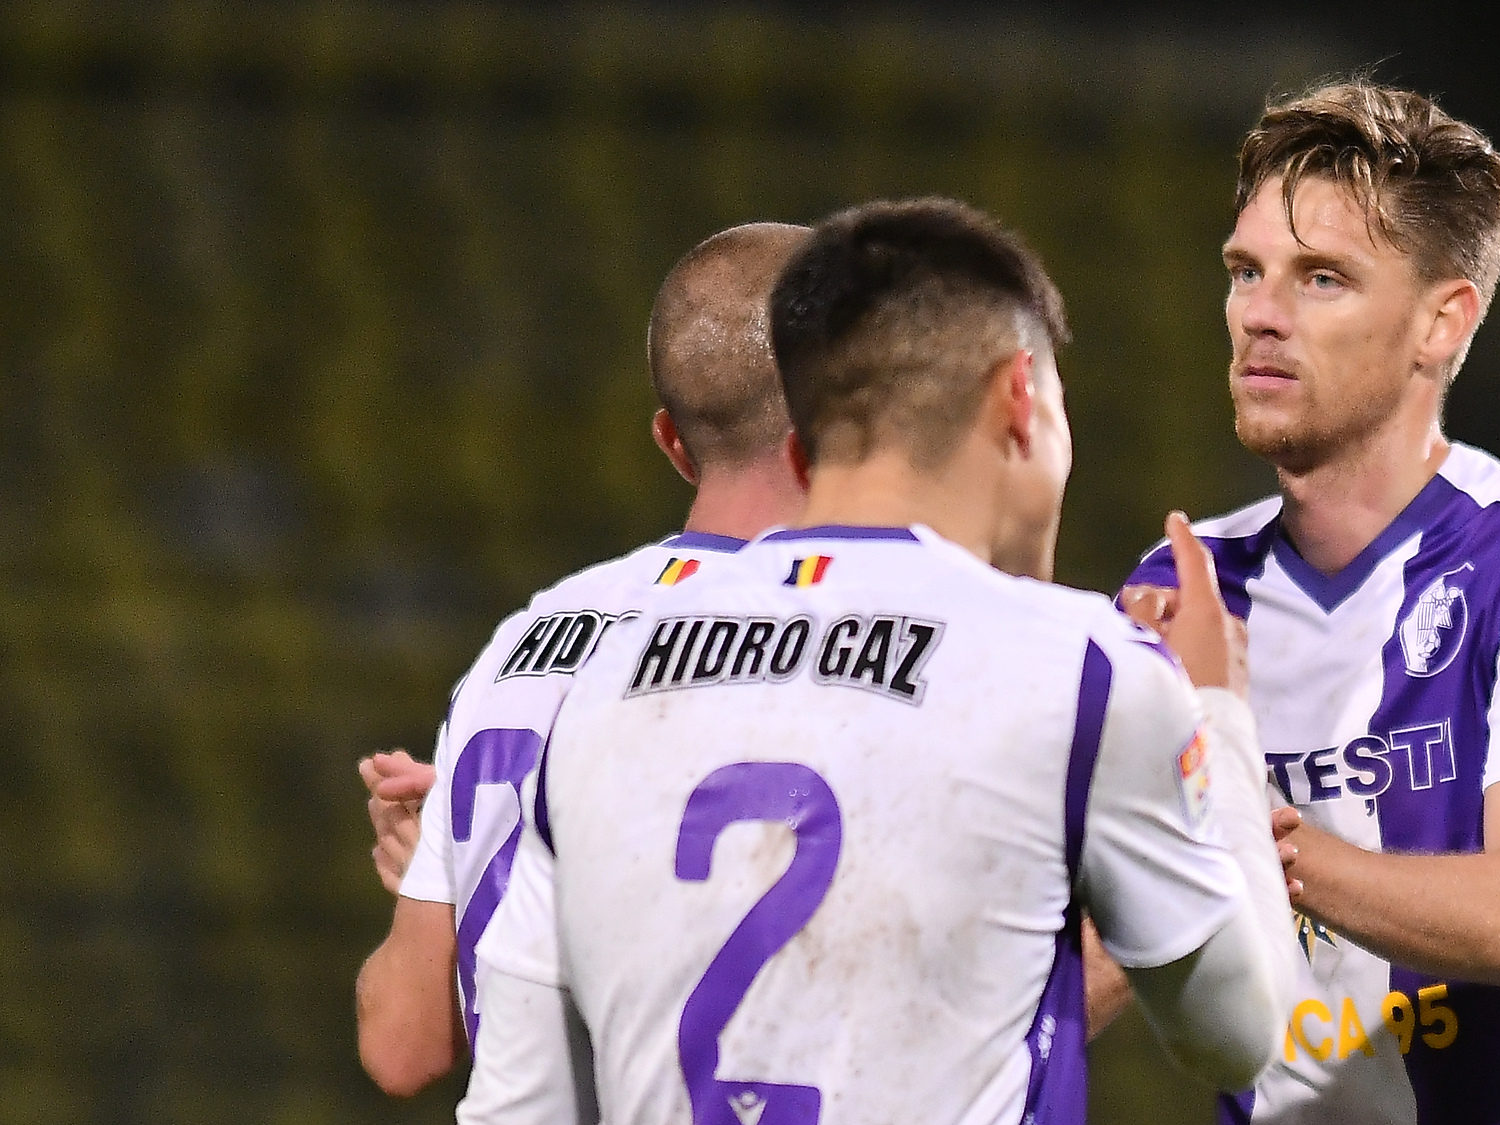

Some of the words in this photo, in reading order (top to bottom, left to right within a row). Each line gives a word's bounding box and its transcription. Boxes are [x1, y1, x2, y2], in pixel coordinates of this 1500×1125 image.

[495, 609, 642, 683] HID
[624, 614, 812, 699] HIDRO
[816, 614, 946, 707] GAZ
[1381, 983, 1460, 1056] 95
